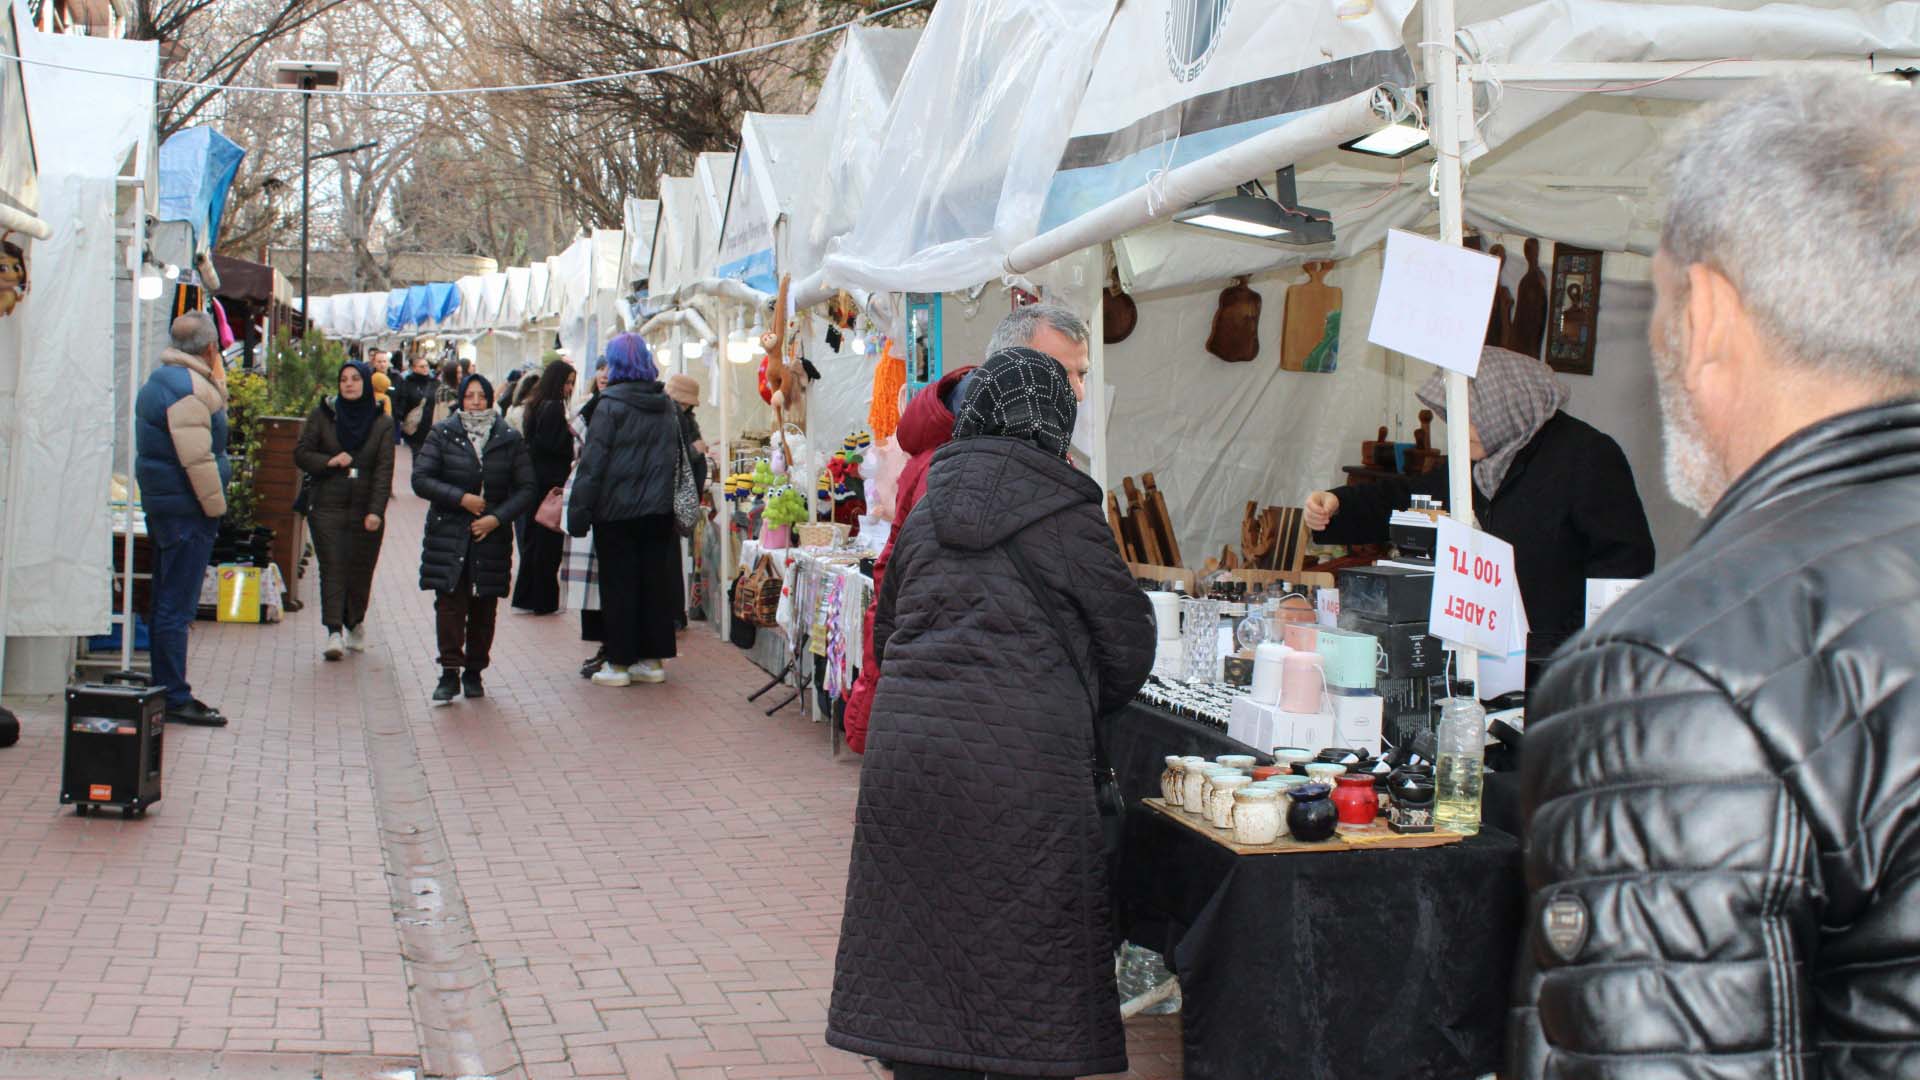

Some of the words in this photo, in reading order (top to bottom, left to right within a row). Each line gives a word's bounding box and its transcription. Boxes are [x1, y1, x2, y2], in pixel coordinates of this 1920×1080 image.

[1449, 545, 1469, 575] TL
[1474, 556, 1502, 587] 100
[1444, 595, 1485, 625] ADET
[1488, 610, 1497, 631] 3
